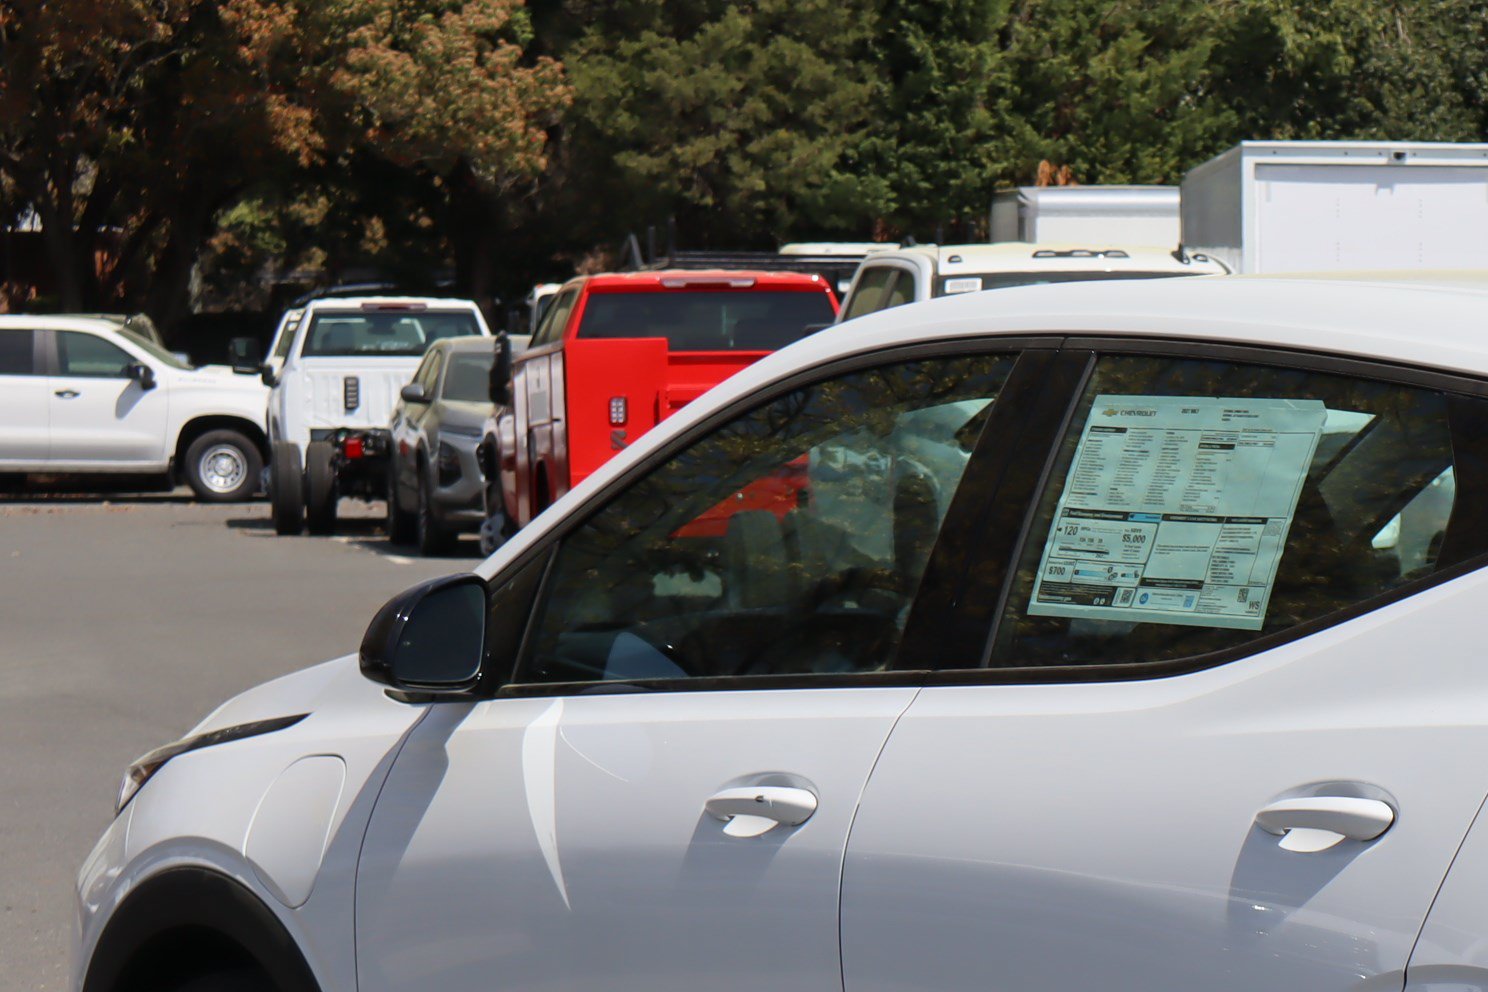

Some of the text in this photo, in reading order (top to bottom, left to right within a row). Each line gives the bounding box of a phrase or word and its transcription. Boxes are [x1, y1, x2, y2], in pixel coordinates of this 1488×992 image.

[1120, 409, 1158, 417] CHEVROLET
[1064, 526, 1079, 536] 120
[1121, 533, 1146, 544] $5,000
[1048, 566, 1066, 576] $700
